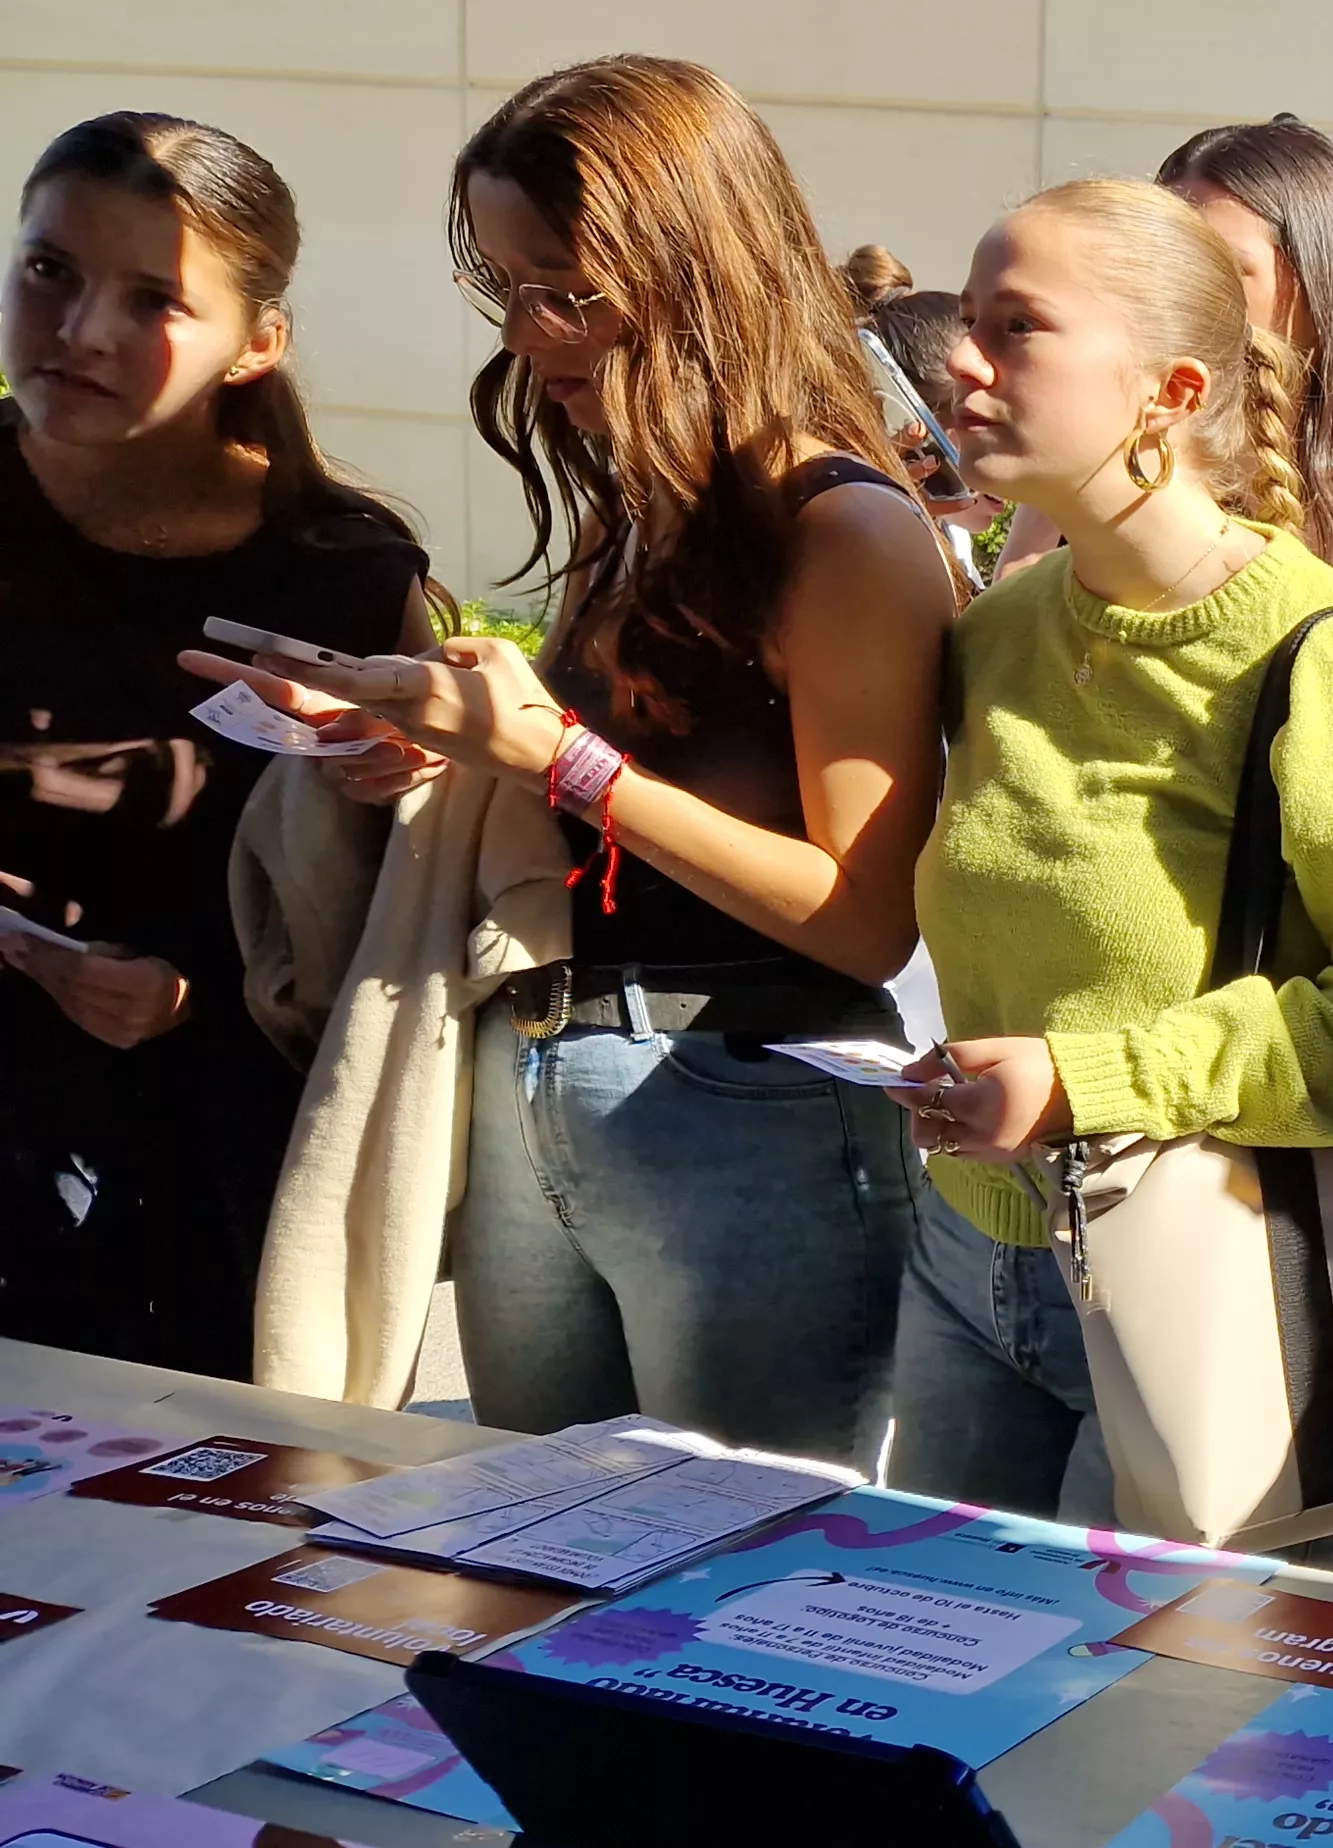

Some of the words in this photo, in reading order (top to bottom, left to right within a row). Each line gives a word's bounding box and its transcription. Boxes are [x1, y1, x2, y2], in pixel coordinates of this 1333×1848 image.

[167, 1492, 198, 1502] el
[199, 1497, 233, 1507] en
[847, 1581, 911, 1600] octubre
[975, 1585, 992, 1593] en
[994, 1589, 1024, 1600] info
[911, 1594, 935, 1604] de
[856, 1605, 897, 1619] años
[952, 1602, 971, 1611] el
[897, 1614, 916, 1623] 18
[971, 1606, 1022, 1621] Hasta
[733, 1613, 775, 1628] años
[877, 1620, 901, 1631] de
[916, 1618, 939, 1627] de
[820, 1632, 844, 1642] de
[900, 1626, 983, 1647] Concurso
[800, 1639, 824, 1650] de
[844, 1637, 903, 1656] juvenil
[824, 1653, 848, 1664] de
[899, 1648, 990, 1673] Modalidad
[848, 1659, 930, 1682] Concurso
[880, 1655, 974, 1681] Modalidad
[836, 1698, 899, 1722] en
